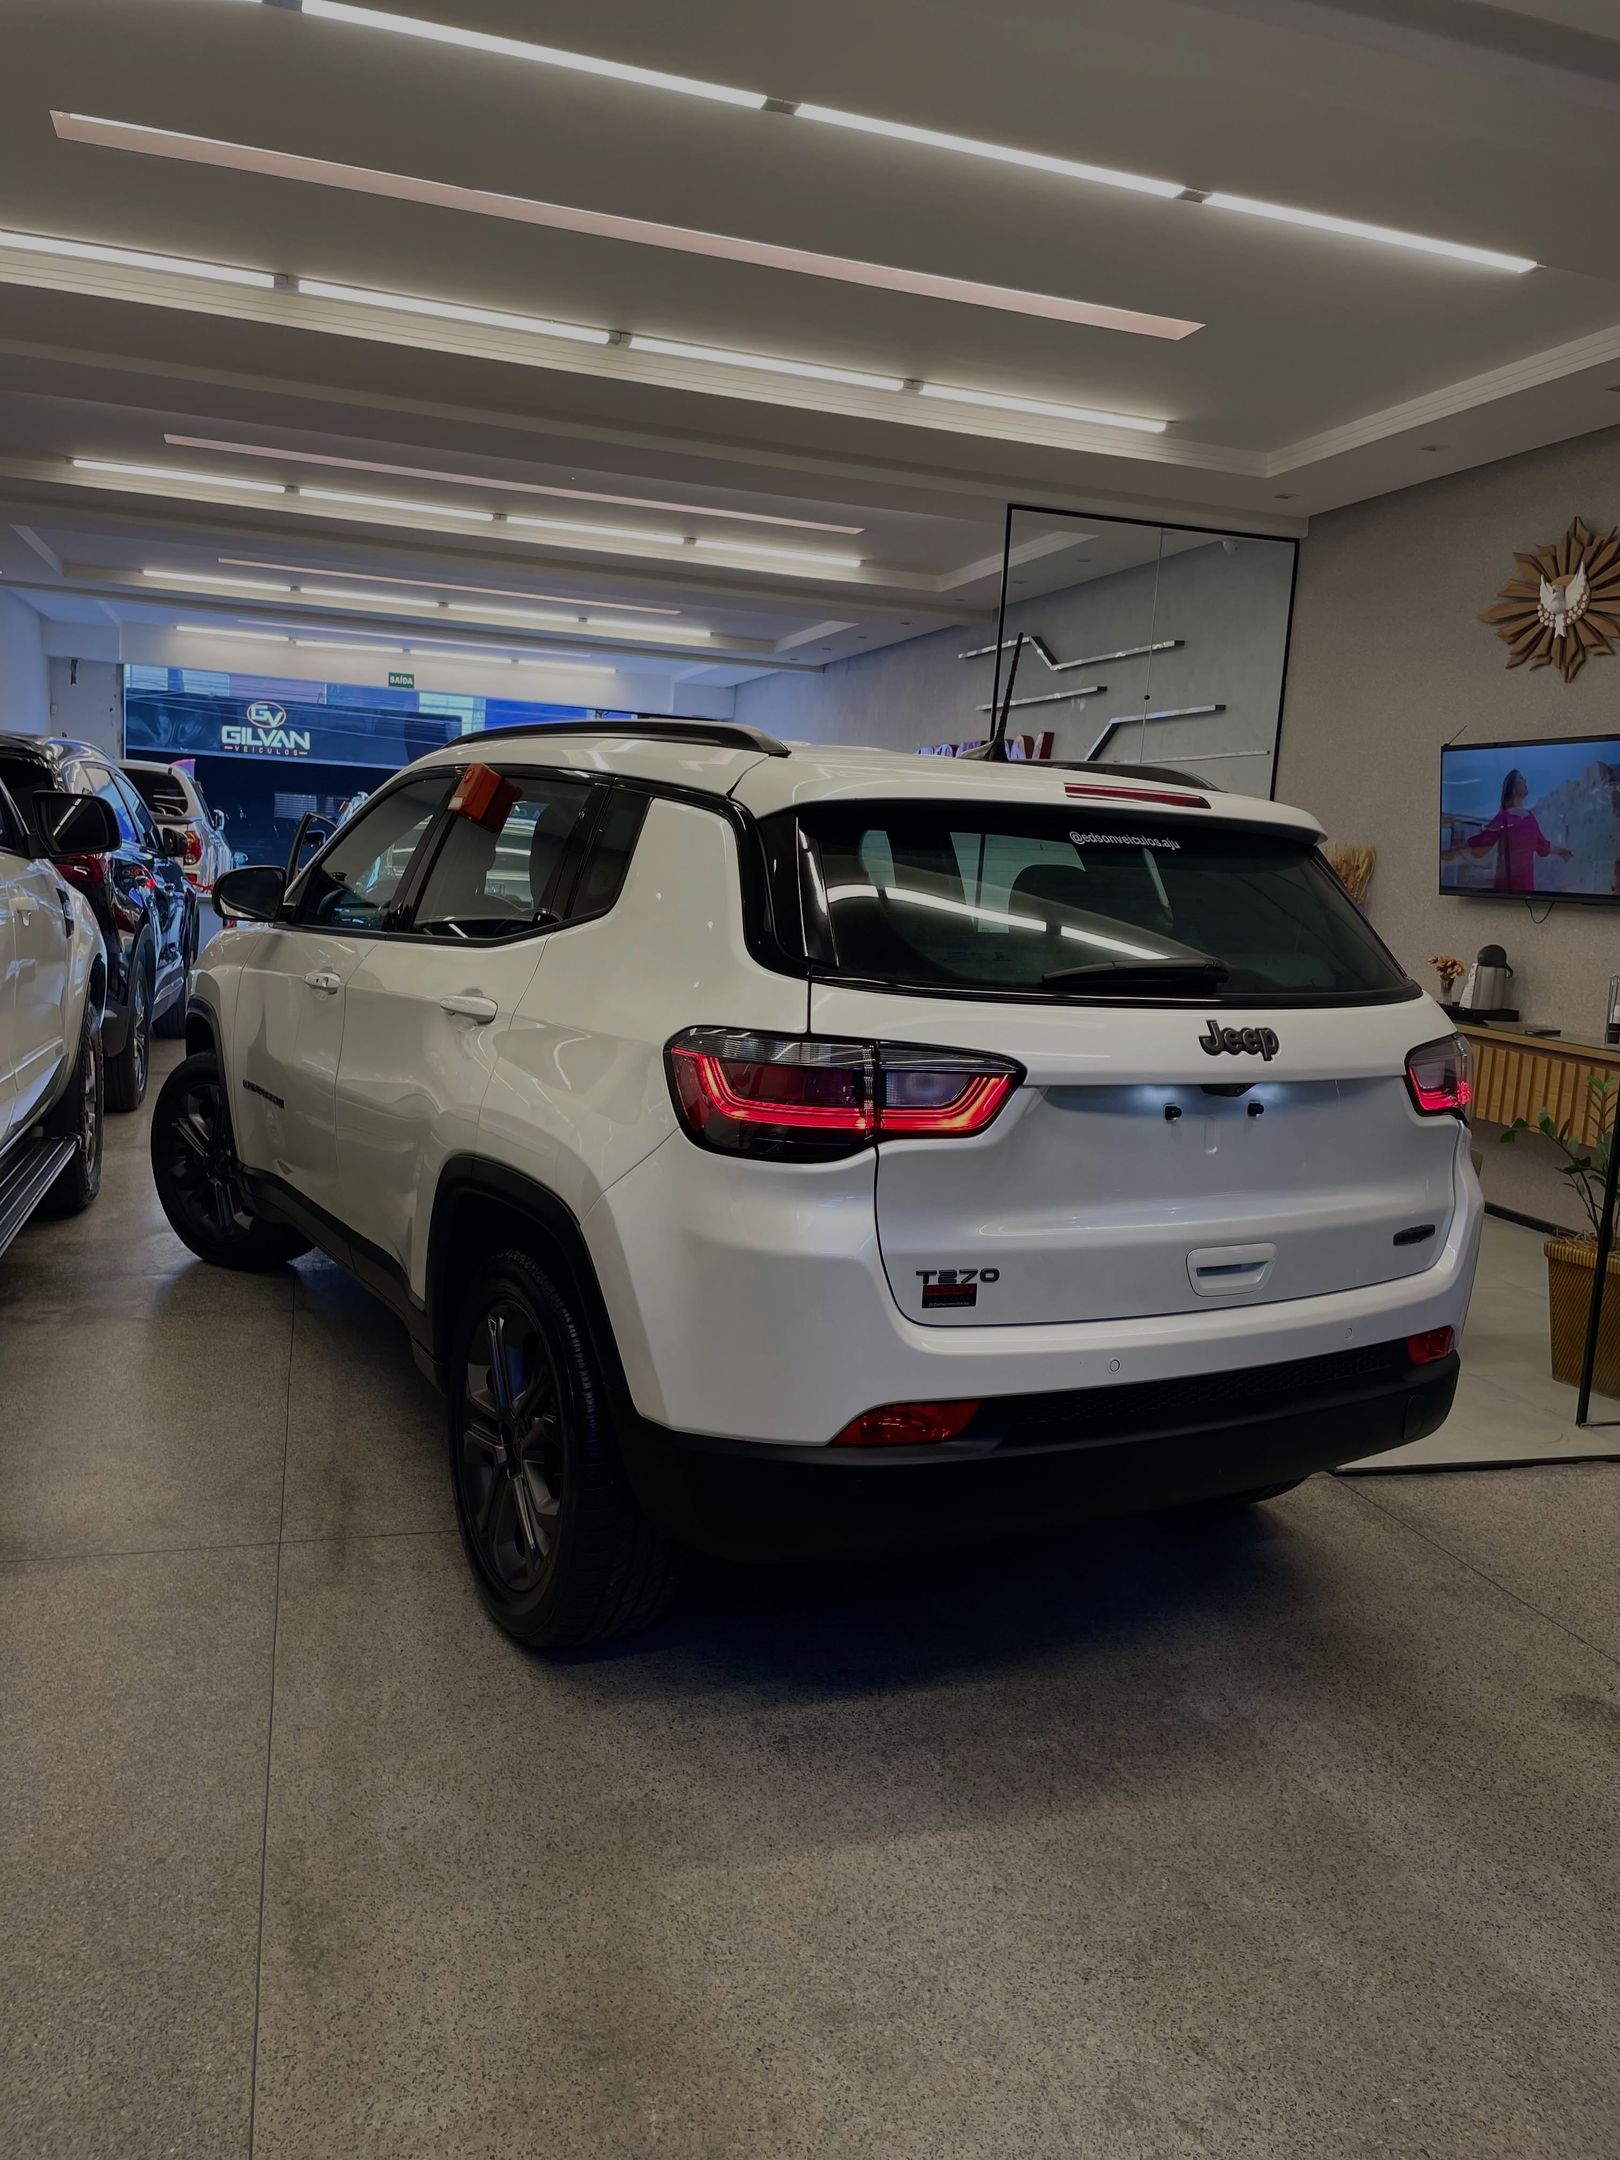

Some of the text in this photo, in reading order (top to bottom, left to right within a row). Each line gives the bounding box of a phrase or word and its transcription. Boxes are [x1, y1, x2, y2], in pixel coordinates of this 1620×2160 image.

[390, 675, 413, 685] SAÍDA
[250, 704, 283, 728] GV
[221, 725, 311, 750] GILVAN
[1069, 831, 1181, 851] @edsonveiculos.aju
[1198, 1019, 1280, 1062] Jeep
[915, 1268, 1000, 1285] T270
